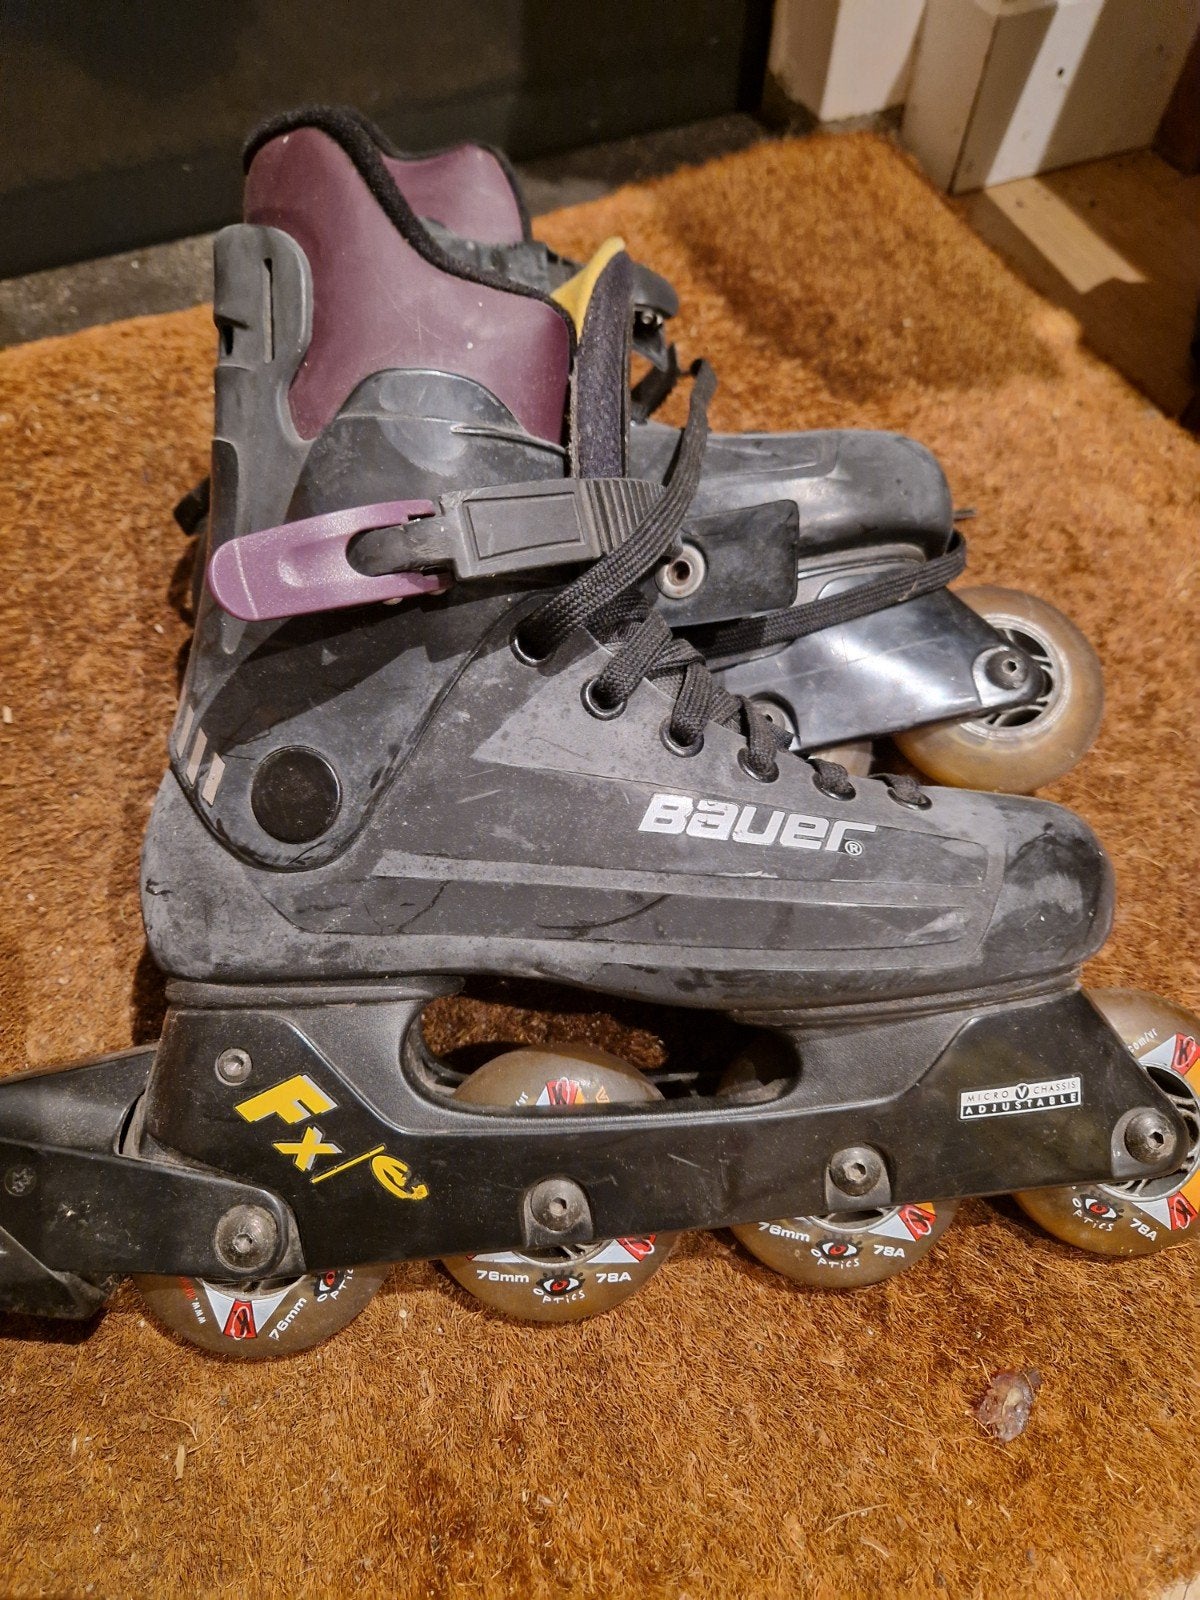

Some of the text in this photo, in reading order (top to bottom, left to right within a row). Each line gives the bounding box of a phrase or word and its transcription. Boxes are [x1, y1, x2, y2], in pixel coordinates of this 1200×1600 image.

[966, 1081, 1076, 1103] MICRO V CHASSIS
[965, 1093, 1077, 1115] ADJUSTABLE
[757, 1221, 811, 1243] 76mm
[1130, 1217, 1158, 1242] 78A
[873, 1244, 906, 1258] 78A
[476, 1269, 531, 1284] 76mm
[595, 1271, 632, 1284] 78A
[268, 1297, 308, 1342] 76mm
